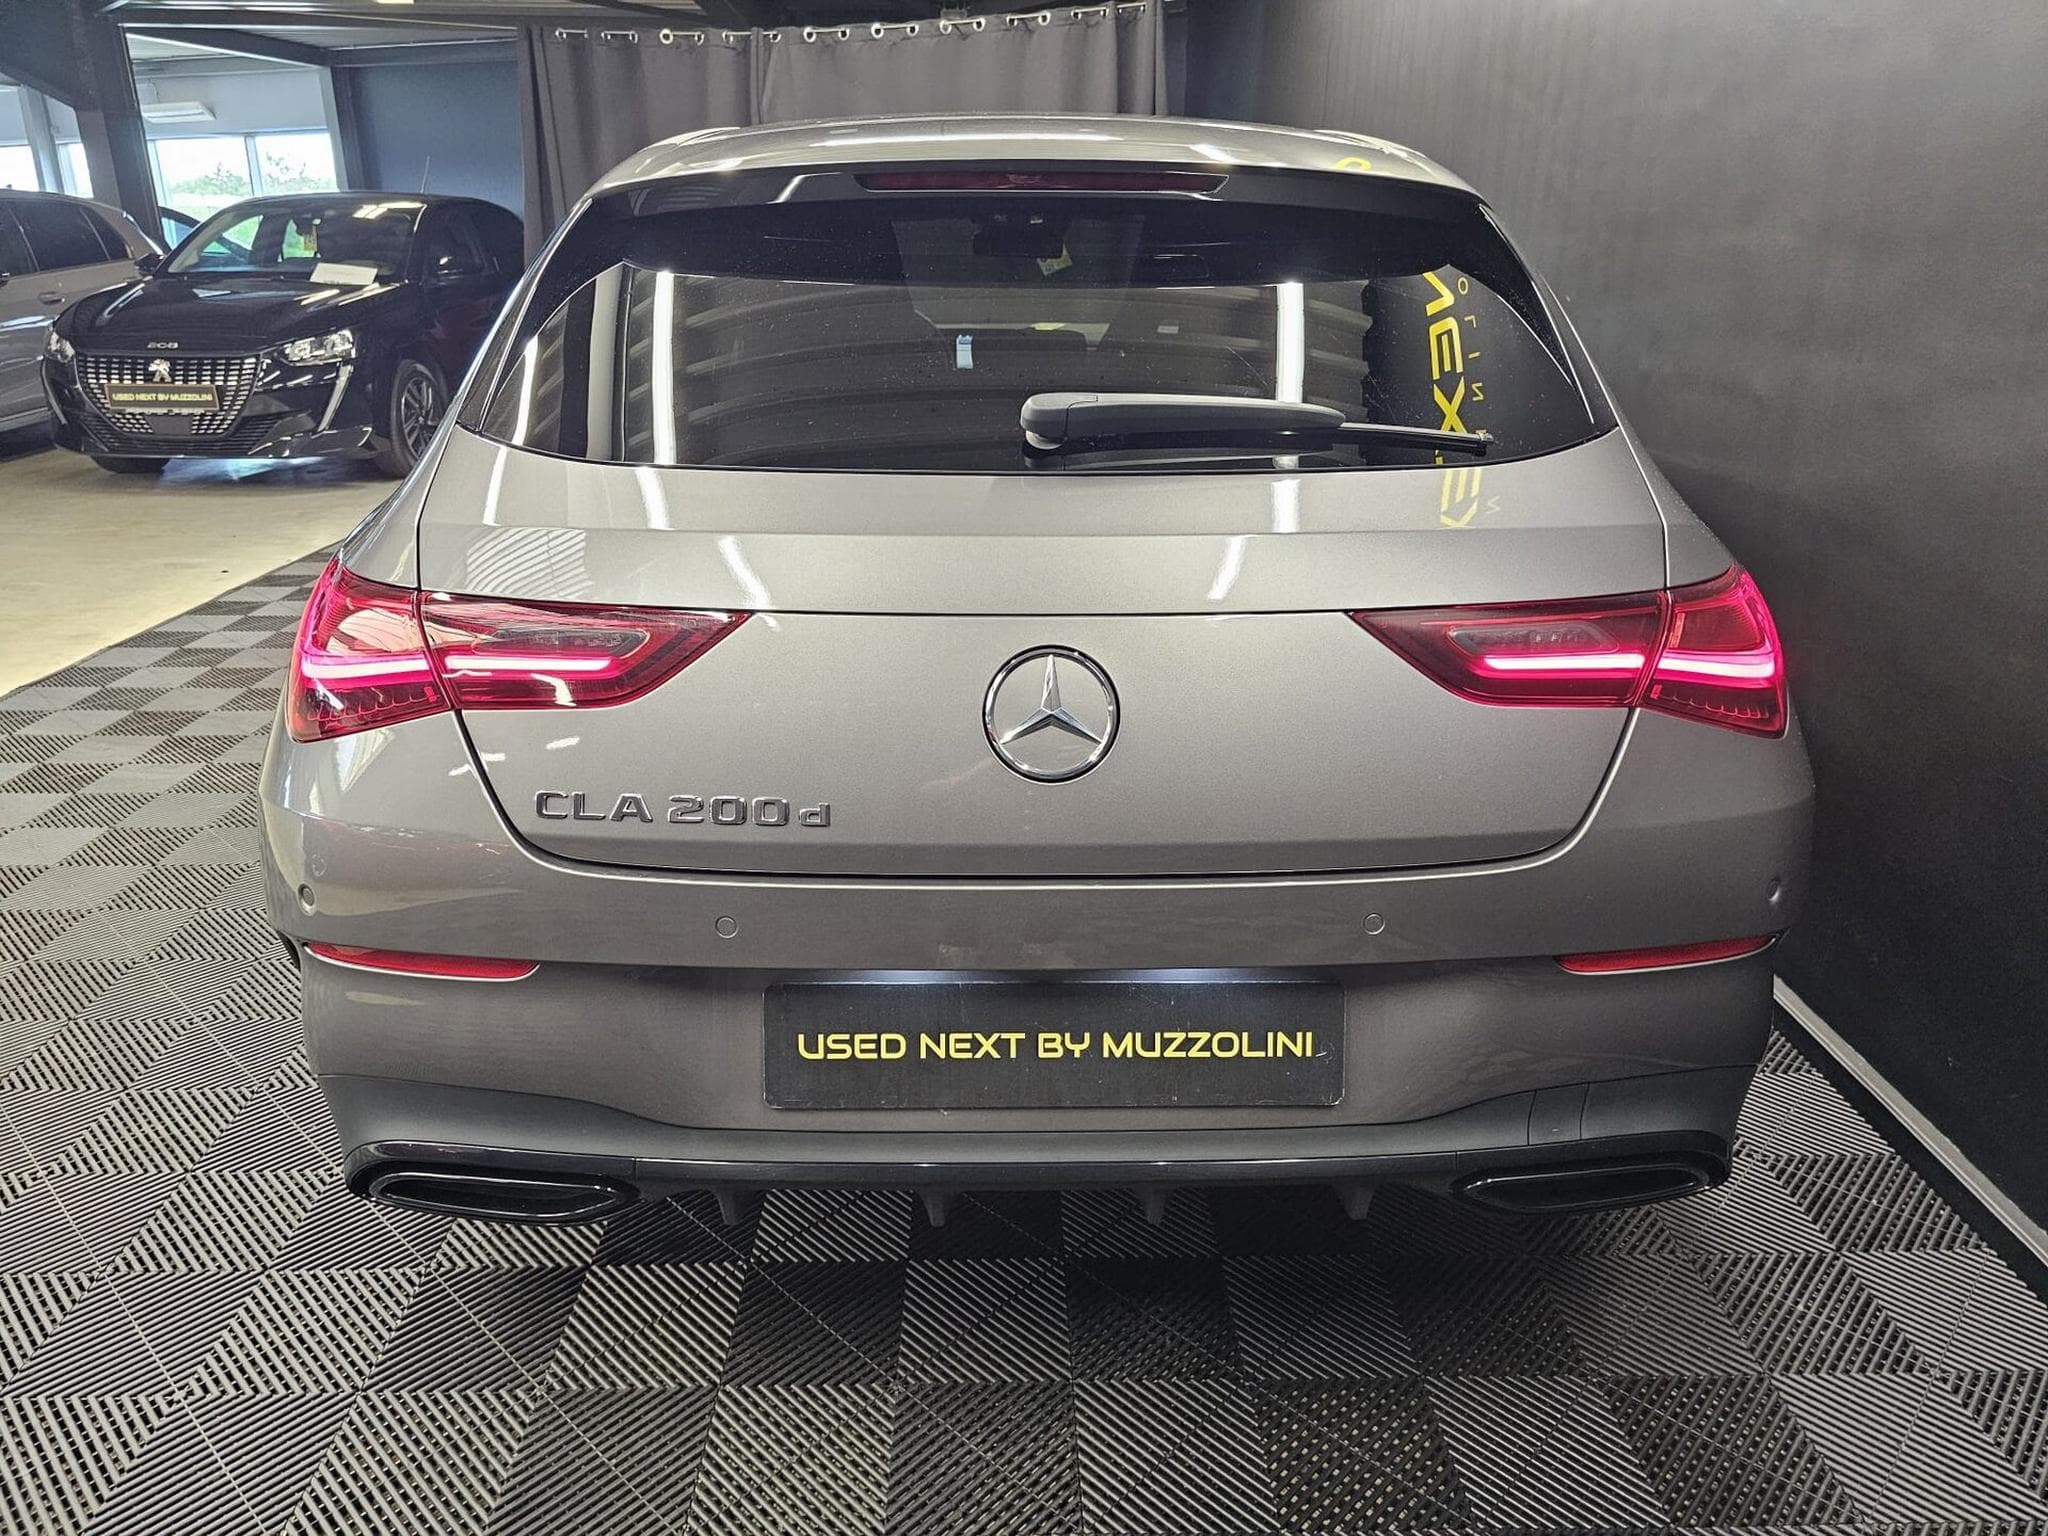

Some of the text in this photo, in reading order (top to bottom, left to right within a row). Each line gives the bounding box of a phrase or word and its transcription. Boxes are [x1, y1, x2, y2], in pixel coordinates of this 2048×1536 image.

[535, 790, 653, 823] CLA
[798, 1031, 1313, 1060] USED NEXT BY MUZZOLINI
